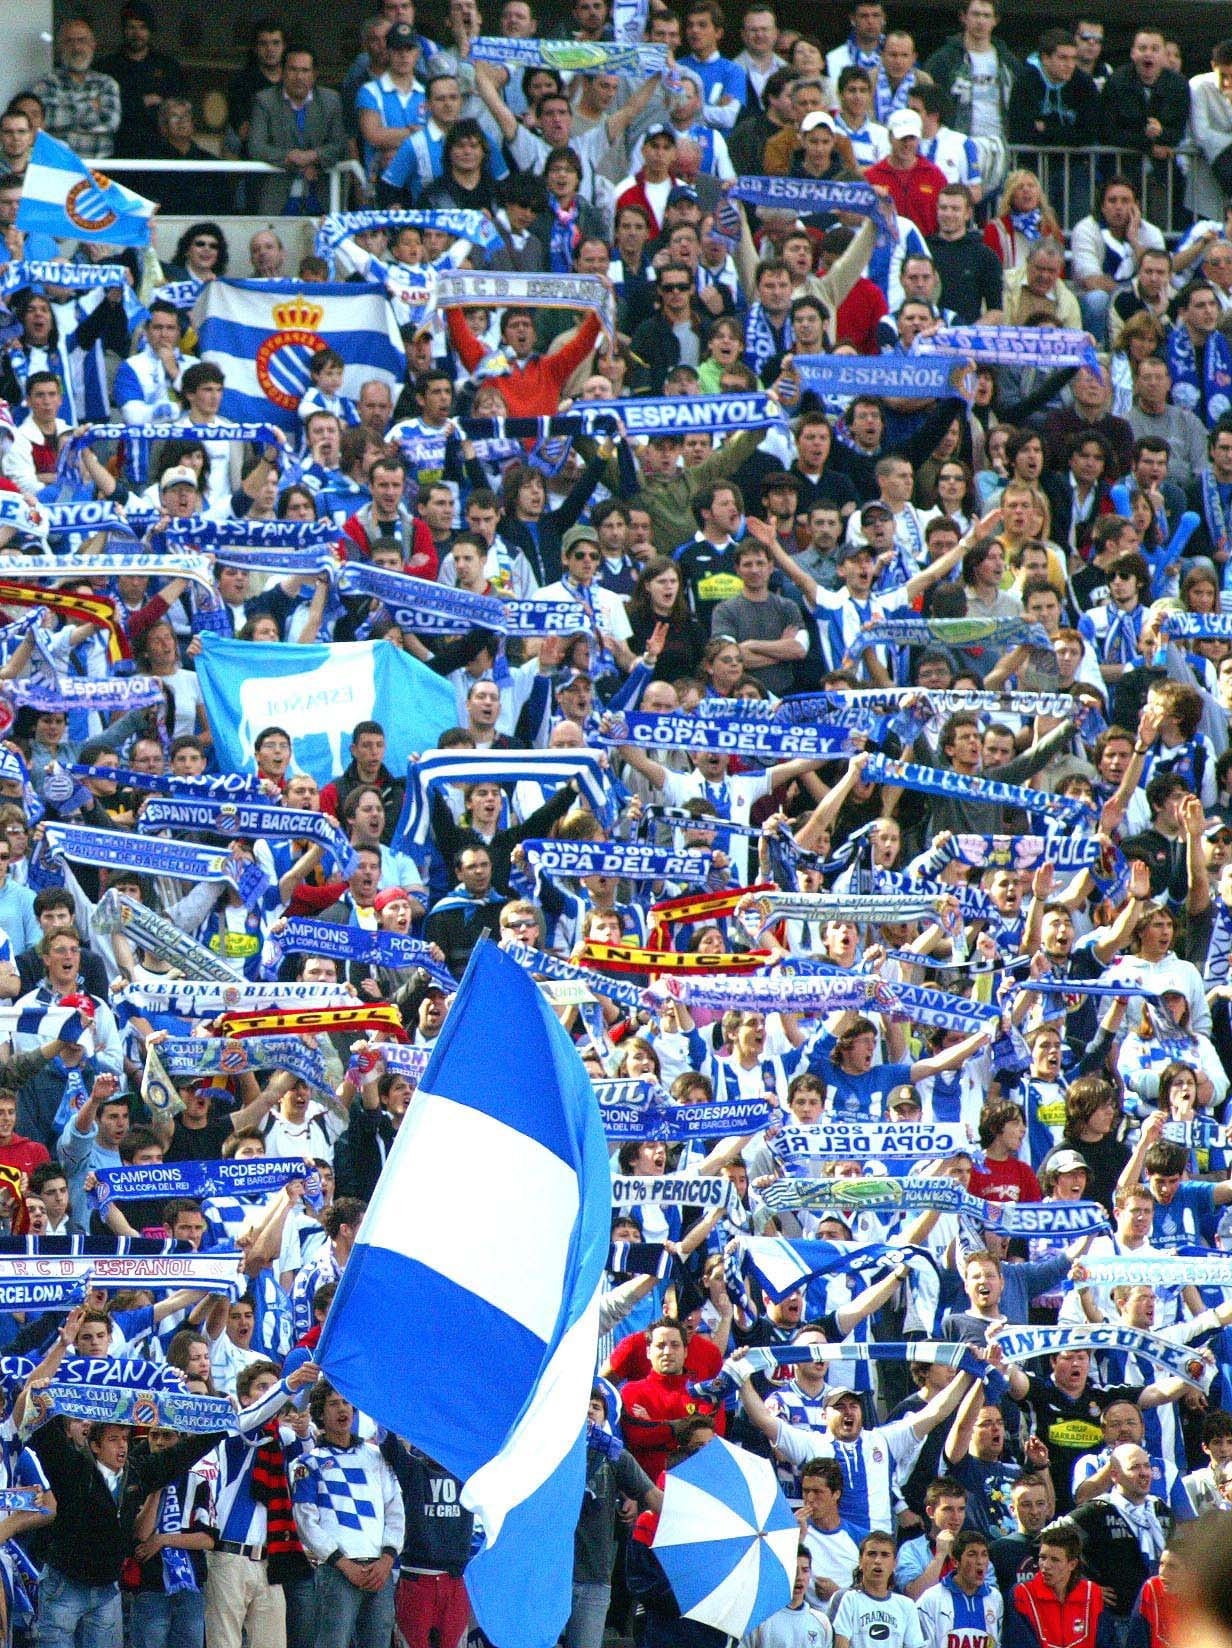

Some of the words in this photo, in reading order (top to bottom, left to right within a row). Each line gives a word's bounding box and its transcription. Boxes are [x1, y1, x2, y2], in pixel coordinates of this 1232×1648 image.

[630, 397, 761, 428] ESPANYOL
[661, 717, 723, 730] FINAL
[635, 726, 714, 743] COPA
[719, 730, 774, 748] DEL
[780, 735, 836, 752] REY
[240, 812, 259, 829] DE
[543, 842, 606, 854] FINAL
[1045, 836, 1099, 866] CULE
[604, 857, 650, 873] DEL
[753, 978, 854, 1003] Espanyol
[676, 1102, 768, 1122] RCDESPANYOL
[108, 1167, 182, 1183] CAMPIONS
[651, 1178, 722, 1203] PERICOS
[87, 1391, 119, 1404] CLUB
[429, 1478, 457, 1503] YO
[860, 1612, 898, 1629] TRAINING
